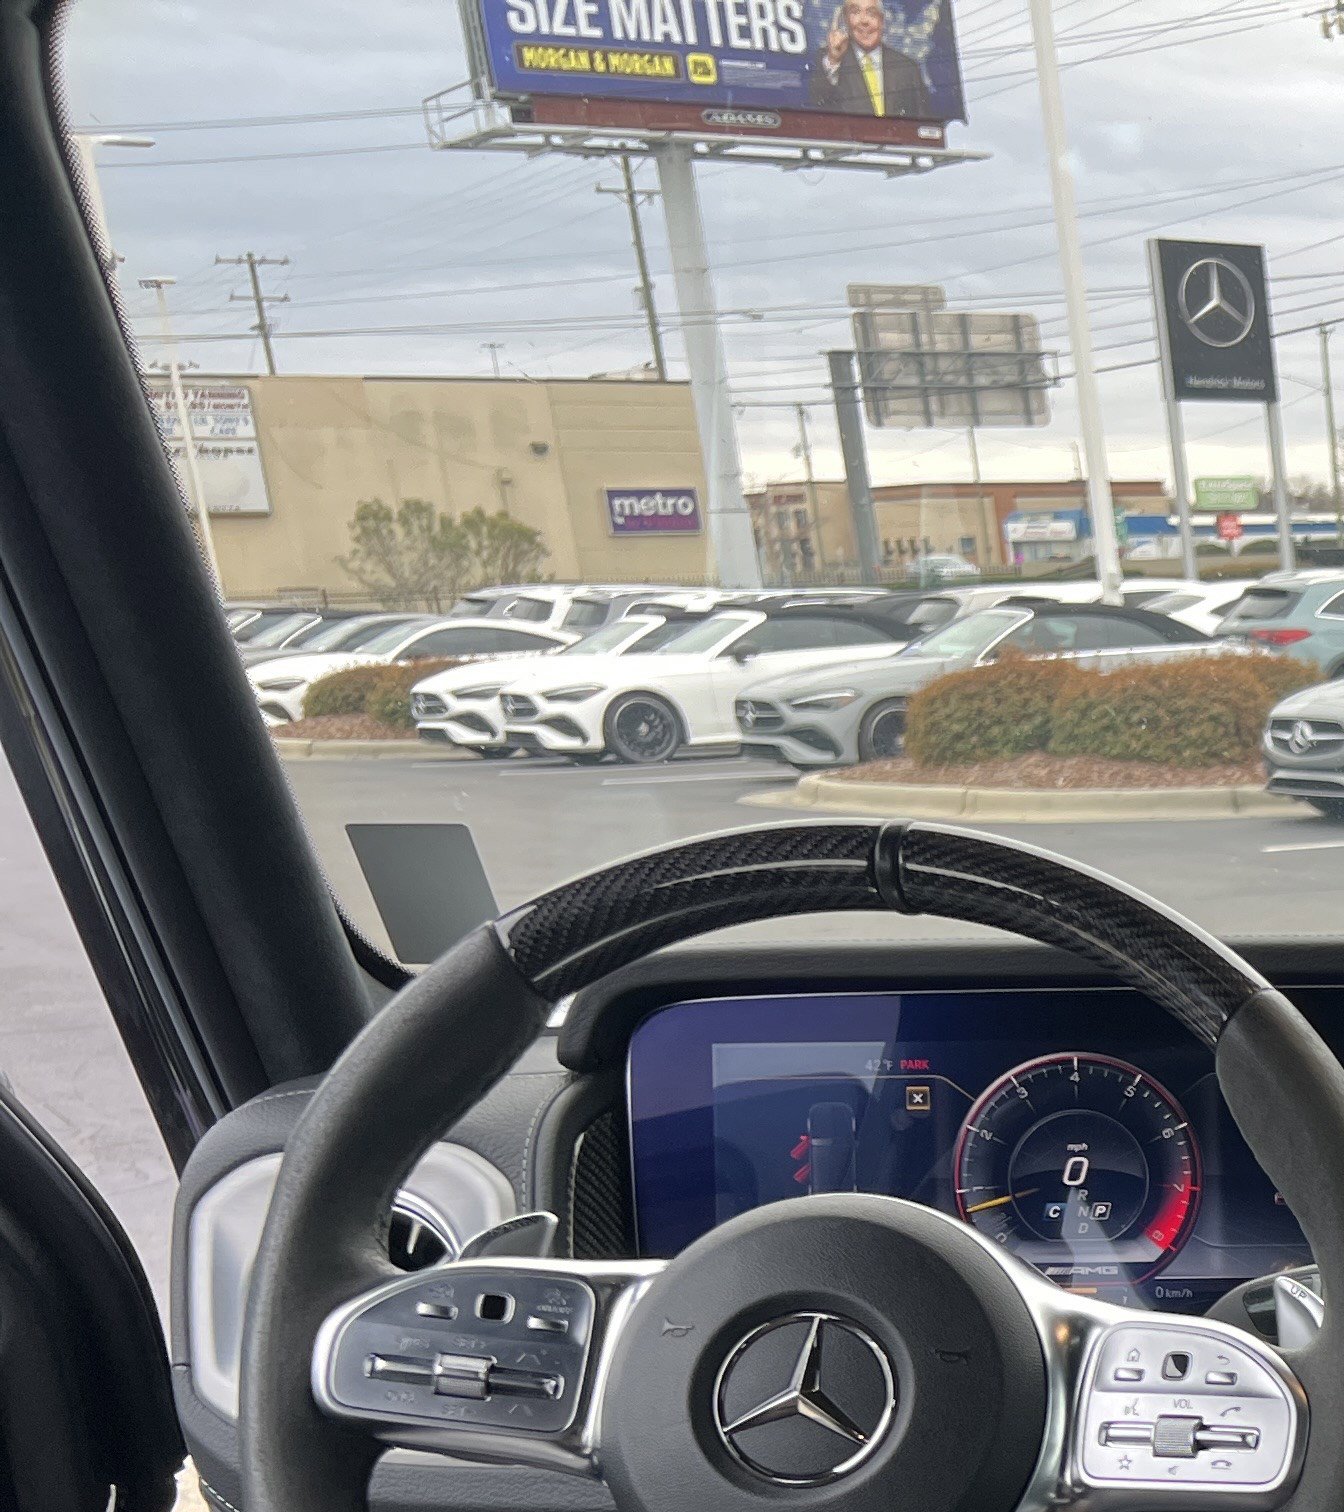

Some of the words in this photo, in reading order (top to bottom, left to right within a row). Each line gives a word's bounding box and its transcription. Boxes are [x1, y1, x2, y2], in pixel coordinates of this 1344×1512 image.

[506, 0, 604, 37] SIZE
[609, 0, 808, 53] MATTERS
[522, 47, 591, 71] MORGAN
[607, 52, 676, 77] MORGAN
[613, 491, 695, 517] metro
[900, 1059, 930, 1071] PARK
[1069, 1073, 1080, 1082] 4
[1017, 1087, 1029, 1099] 3
[1124, 1085, 1138, 1098] 5
[979, 1129, 993, 1141] 2
[1161, 1128, 1175, 1140] 6
[1066, 1142, 1089, 1153] mph
[1062, 1156, 1090, 1186] 0
[1077, 1188, 1089, 1201] R
[1048, 1205, 1062, 1218] C
[1077, 1208, 1089, 1218] N
[1094, 1205, 1107, 1217] P
[1077, 1222, 1090, 1234] D
[1071, 1265, 1119, 1276] AMG
[1155, 1286, 1165, 1298] 0
[1165, 1288, 1194, 1299] km/h
[1290, 1284, 1308, 1299] UP
[1172, 1398, 1194, 1410] VOL
